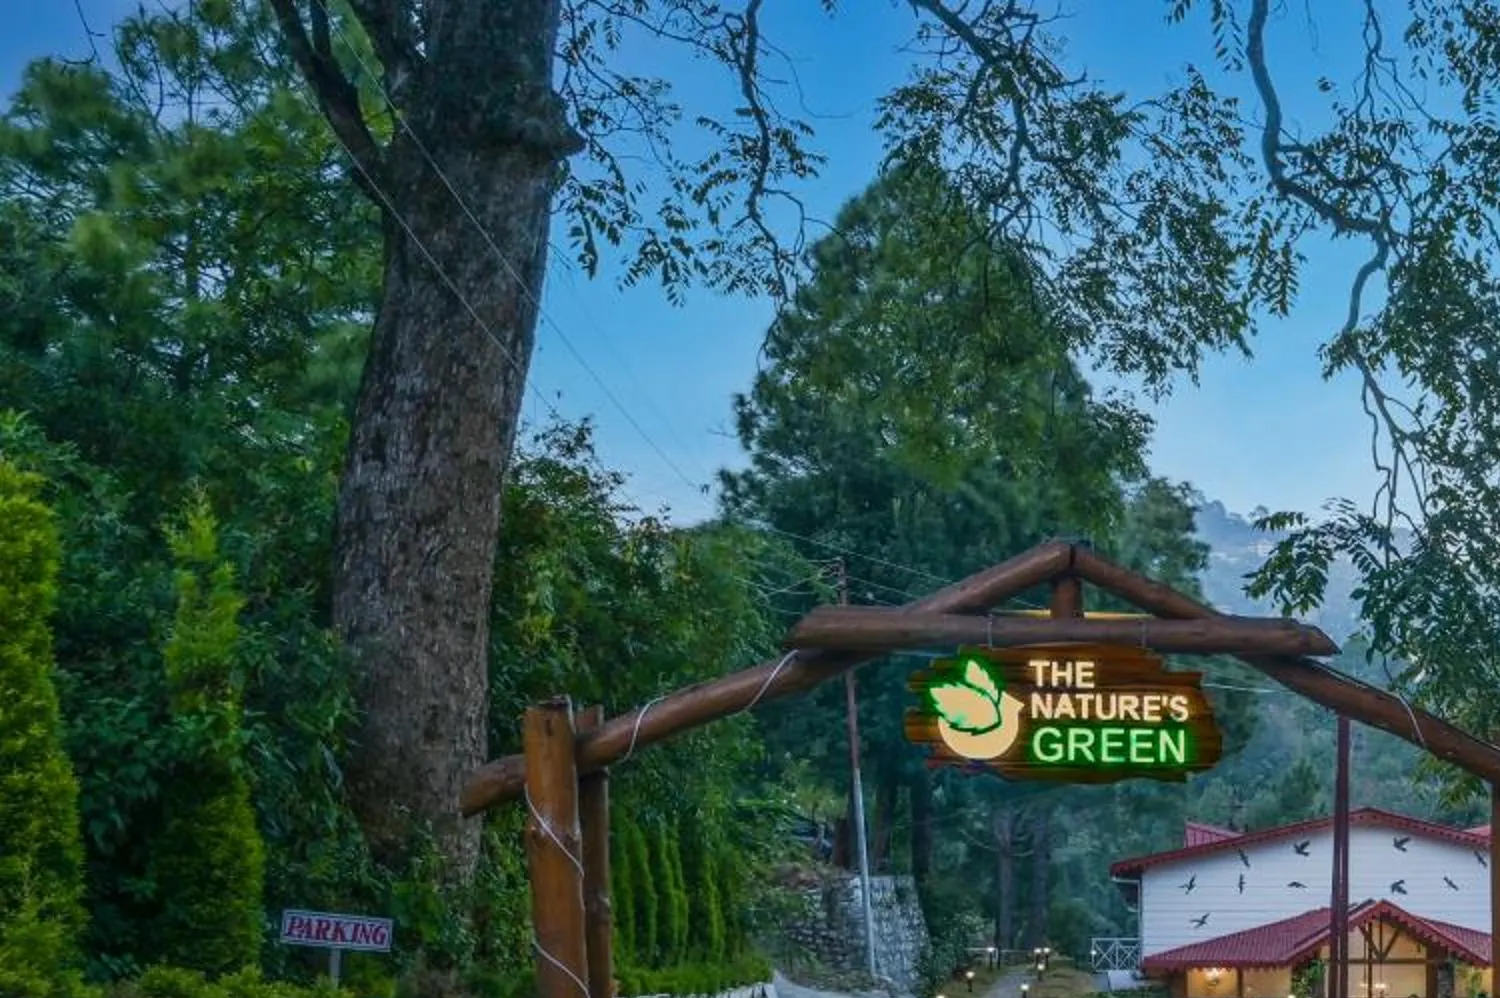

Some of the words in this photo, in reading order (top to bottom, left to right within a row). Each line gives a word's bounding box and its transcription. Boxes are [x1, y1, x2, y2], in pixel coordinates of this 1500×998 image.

[1029, 660, 1095, 688] THE
[1031, 692, 1189, 722] NATURE'S
[1032, 727, 1186, 763] GREEN
[286, 915, 388, 946] PARKING
